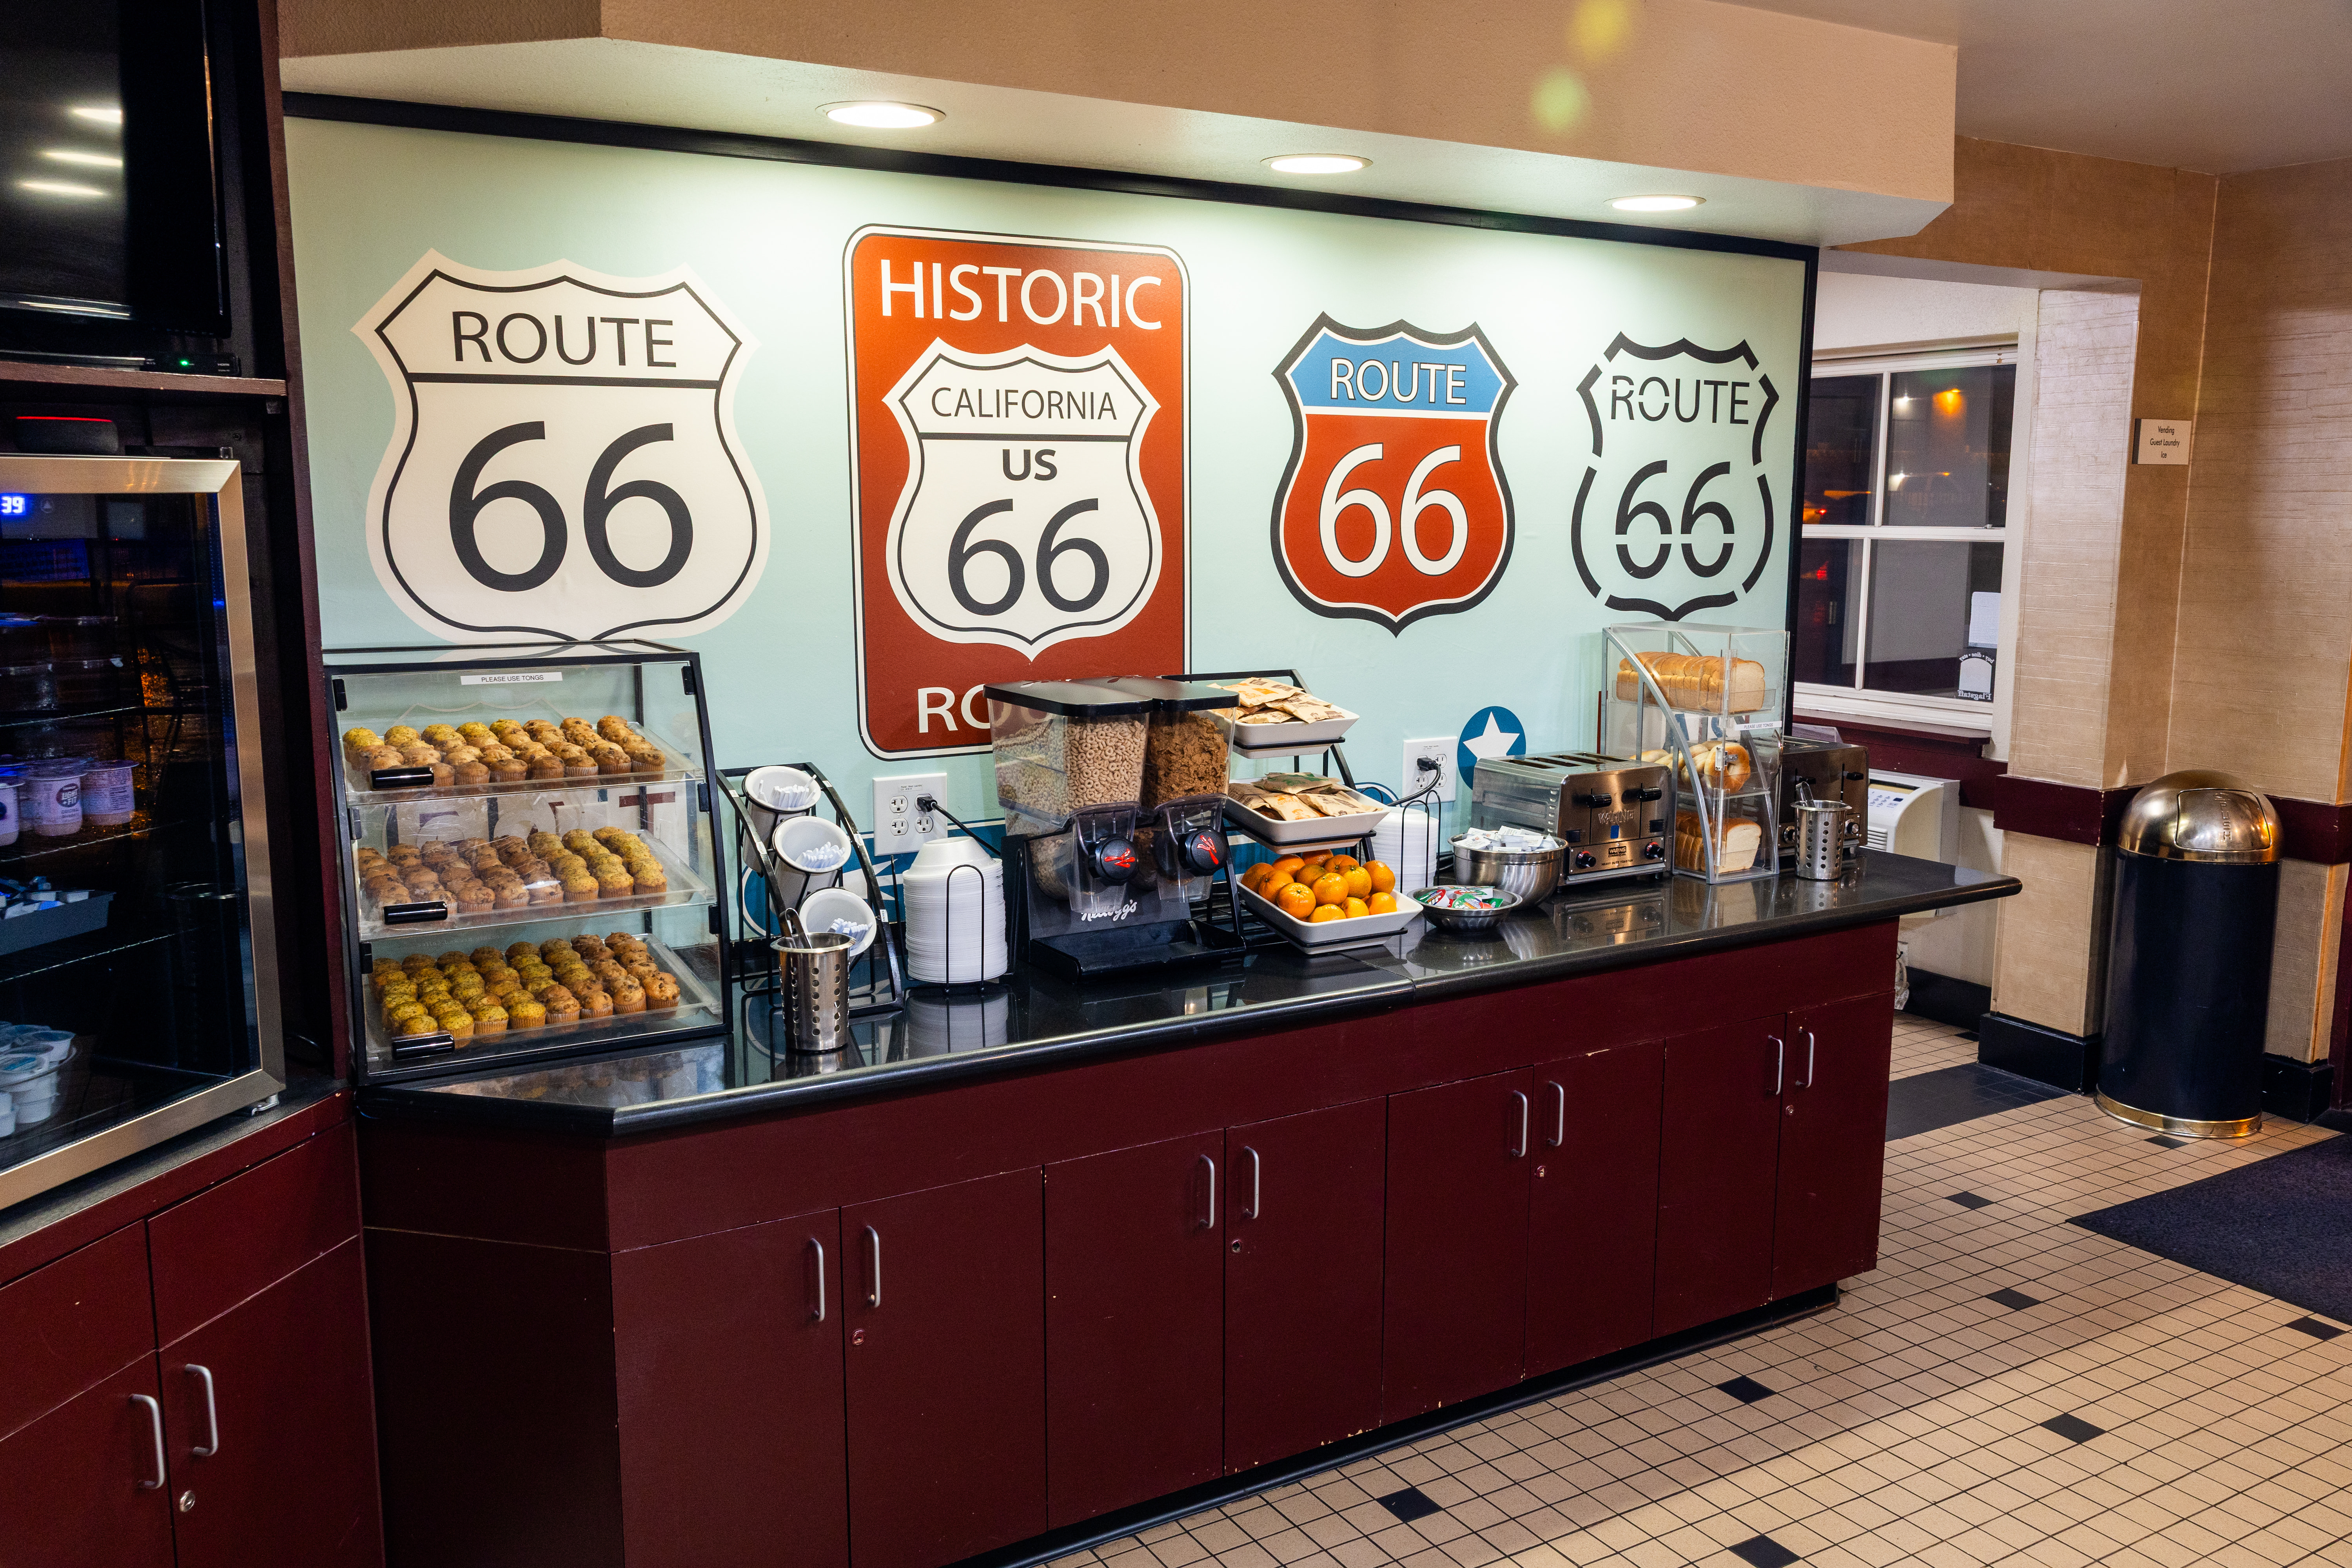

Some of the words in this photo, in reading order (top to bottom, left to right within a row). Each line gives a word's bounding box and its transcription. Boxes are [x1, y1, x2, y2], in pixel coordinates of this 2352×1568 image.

[881, 259, 1162, 330] HISTORIC
[452, 311, 677, 368] ROUTE
[931, 387, 1117, 420] CALIFORNIA
[1331, 358, 1467, 405] ROUTE
[1611, 375, 1750, 425] ROUTE
[2158, 426, 2174, 435] Vending
[2163, 439, 2180, 448] Laundry
[1002, 449, 1058, 481] US
[2, 496, 23, 513] 39
[449, 421, 693, 592] 66
[1319, 442, 1468, 578] 66
[1615, 460, 1735, 579] 66
[948, 498, 1109, 615] 66
[1598, 809, 1635, 825] WARING
